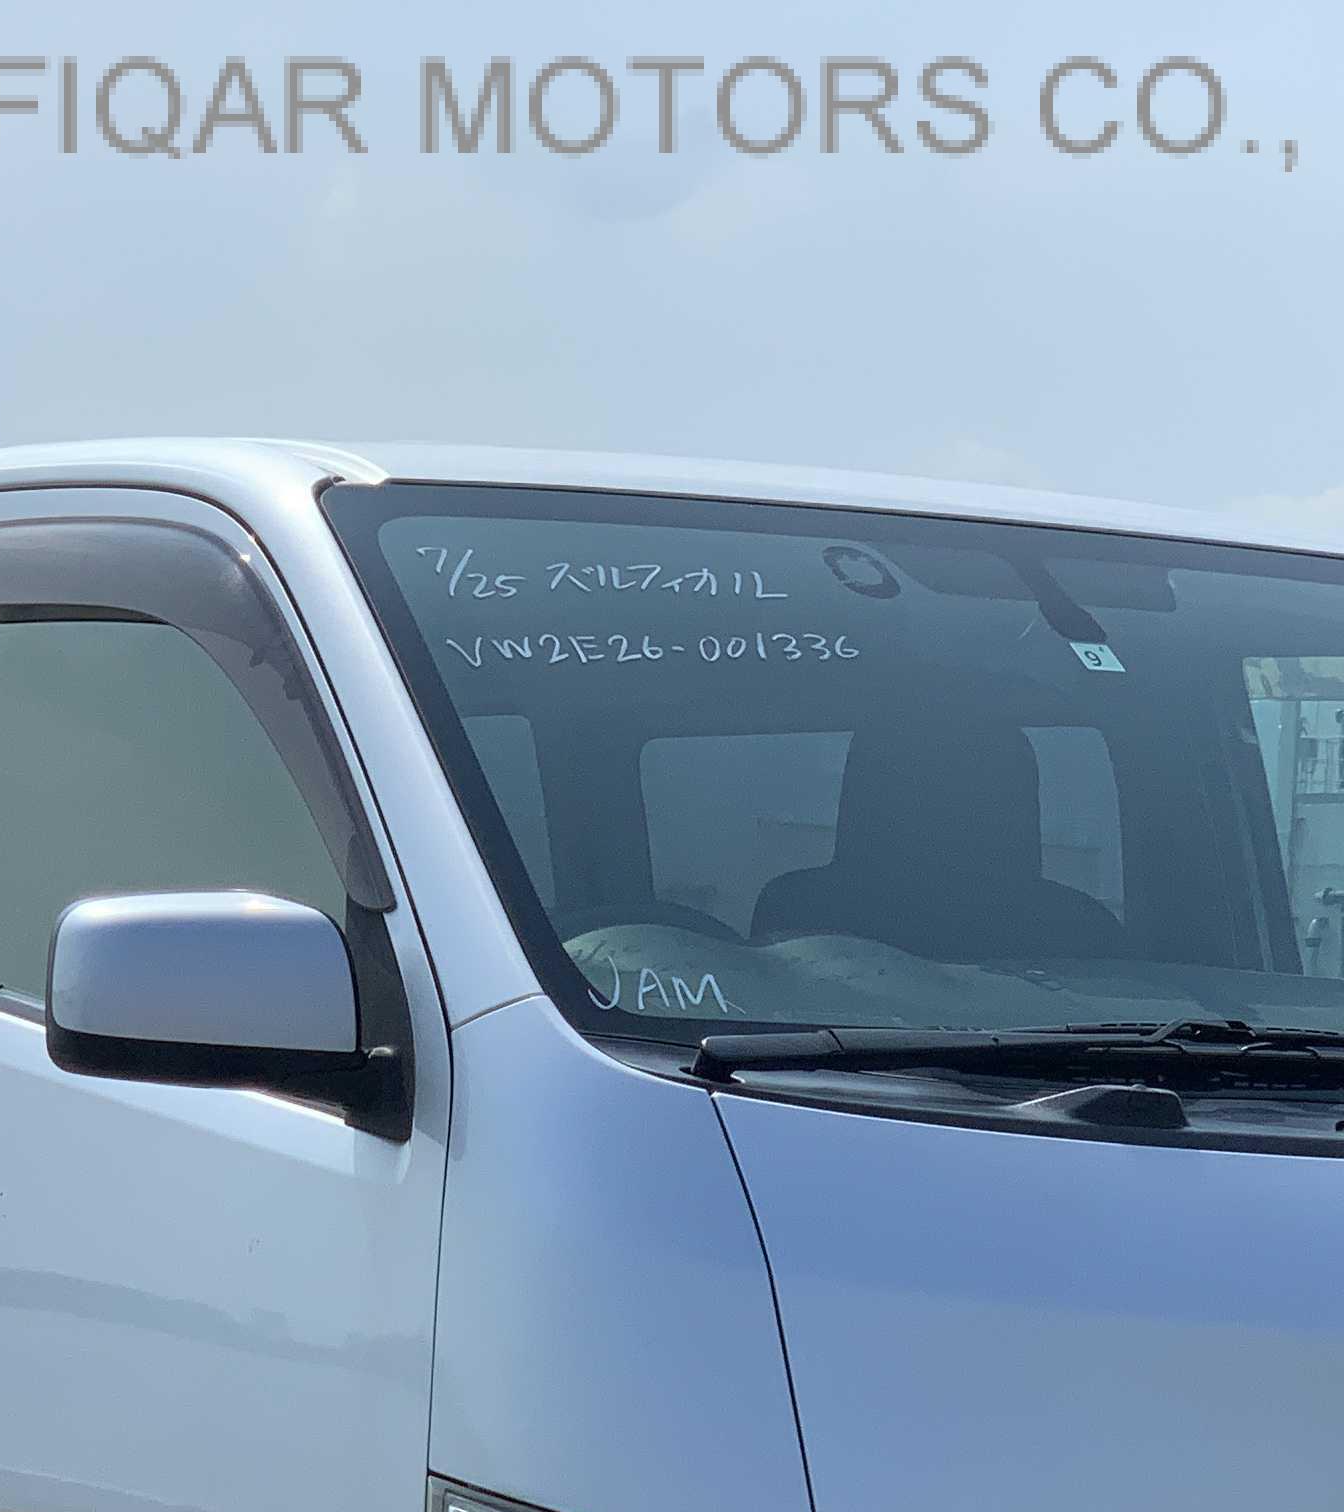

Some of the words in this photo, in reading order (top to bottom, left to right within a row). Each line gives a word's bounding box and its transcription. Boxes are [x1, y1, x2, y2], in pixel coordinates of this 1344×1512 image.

[416, 546, 527, 599] 7/25
[445, 632, 861, 668] VW2E26-001336
[587, 954, 746, 1014] JAM
